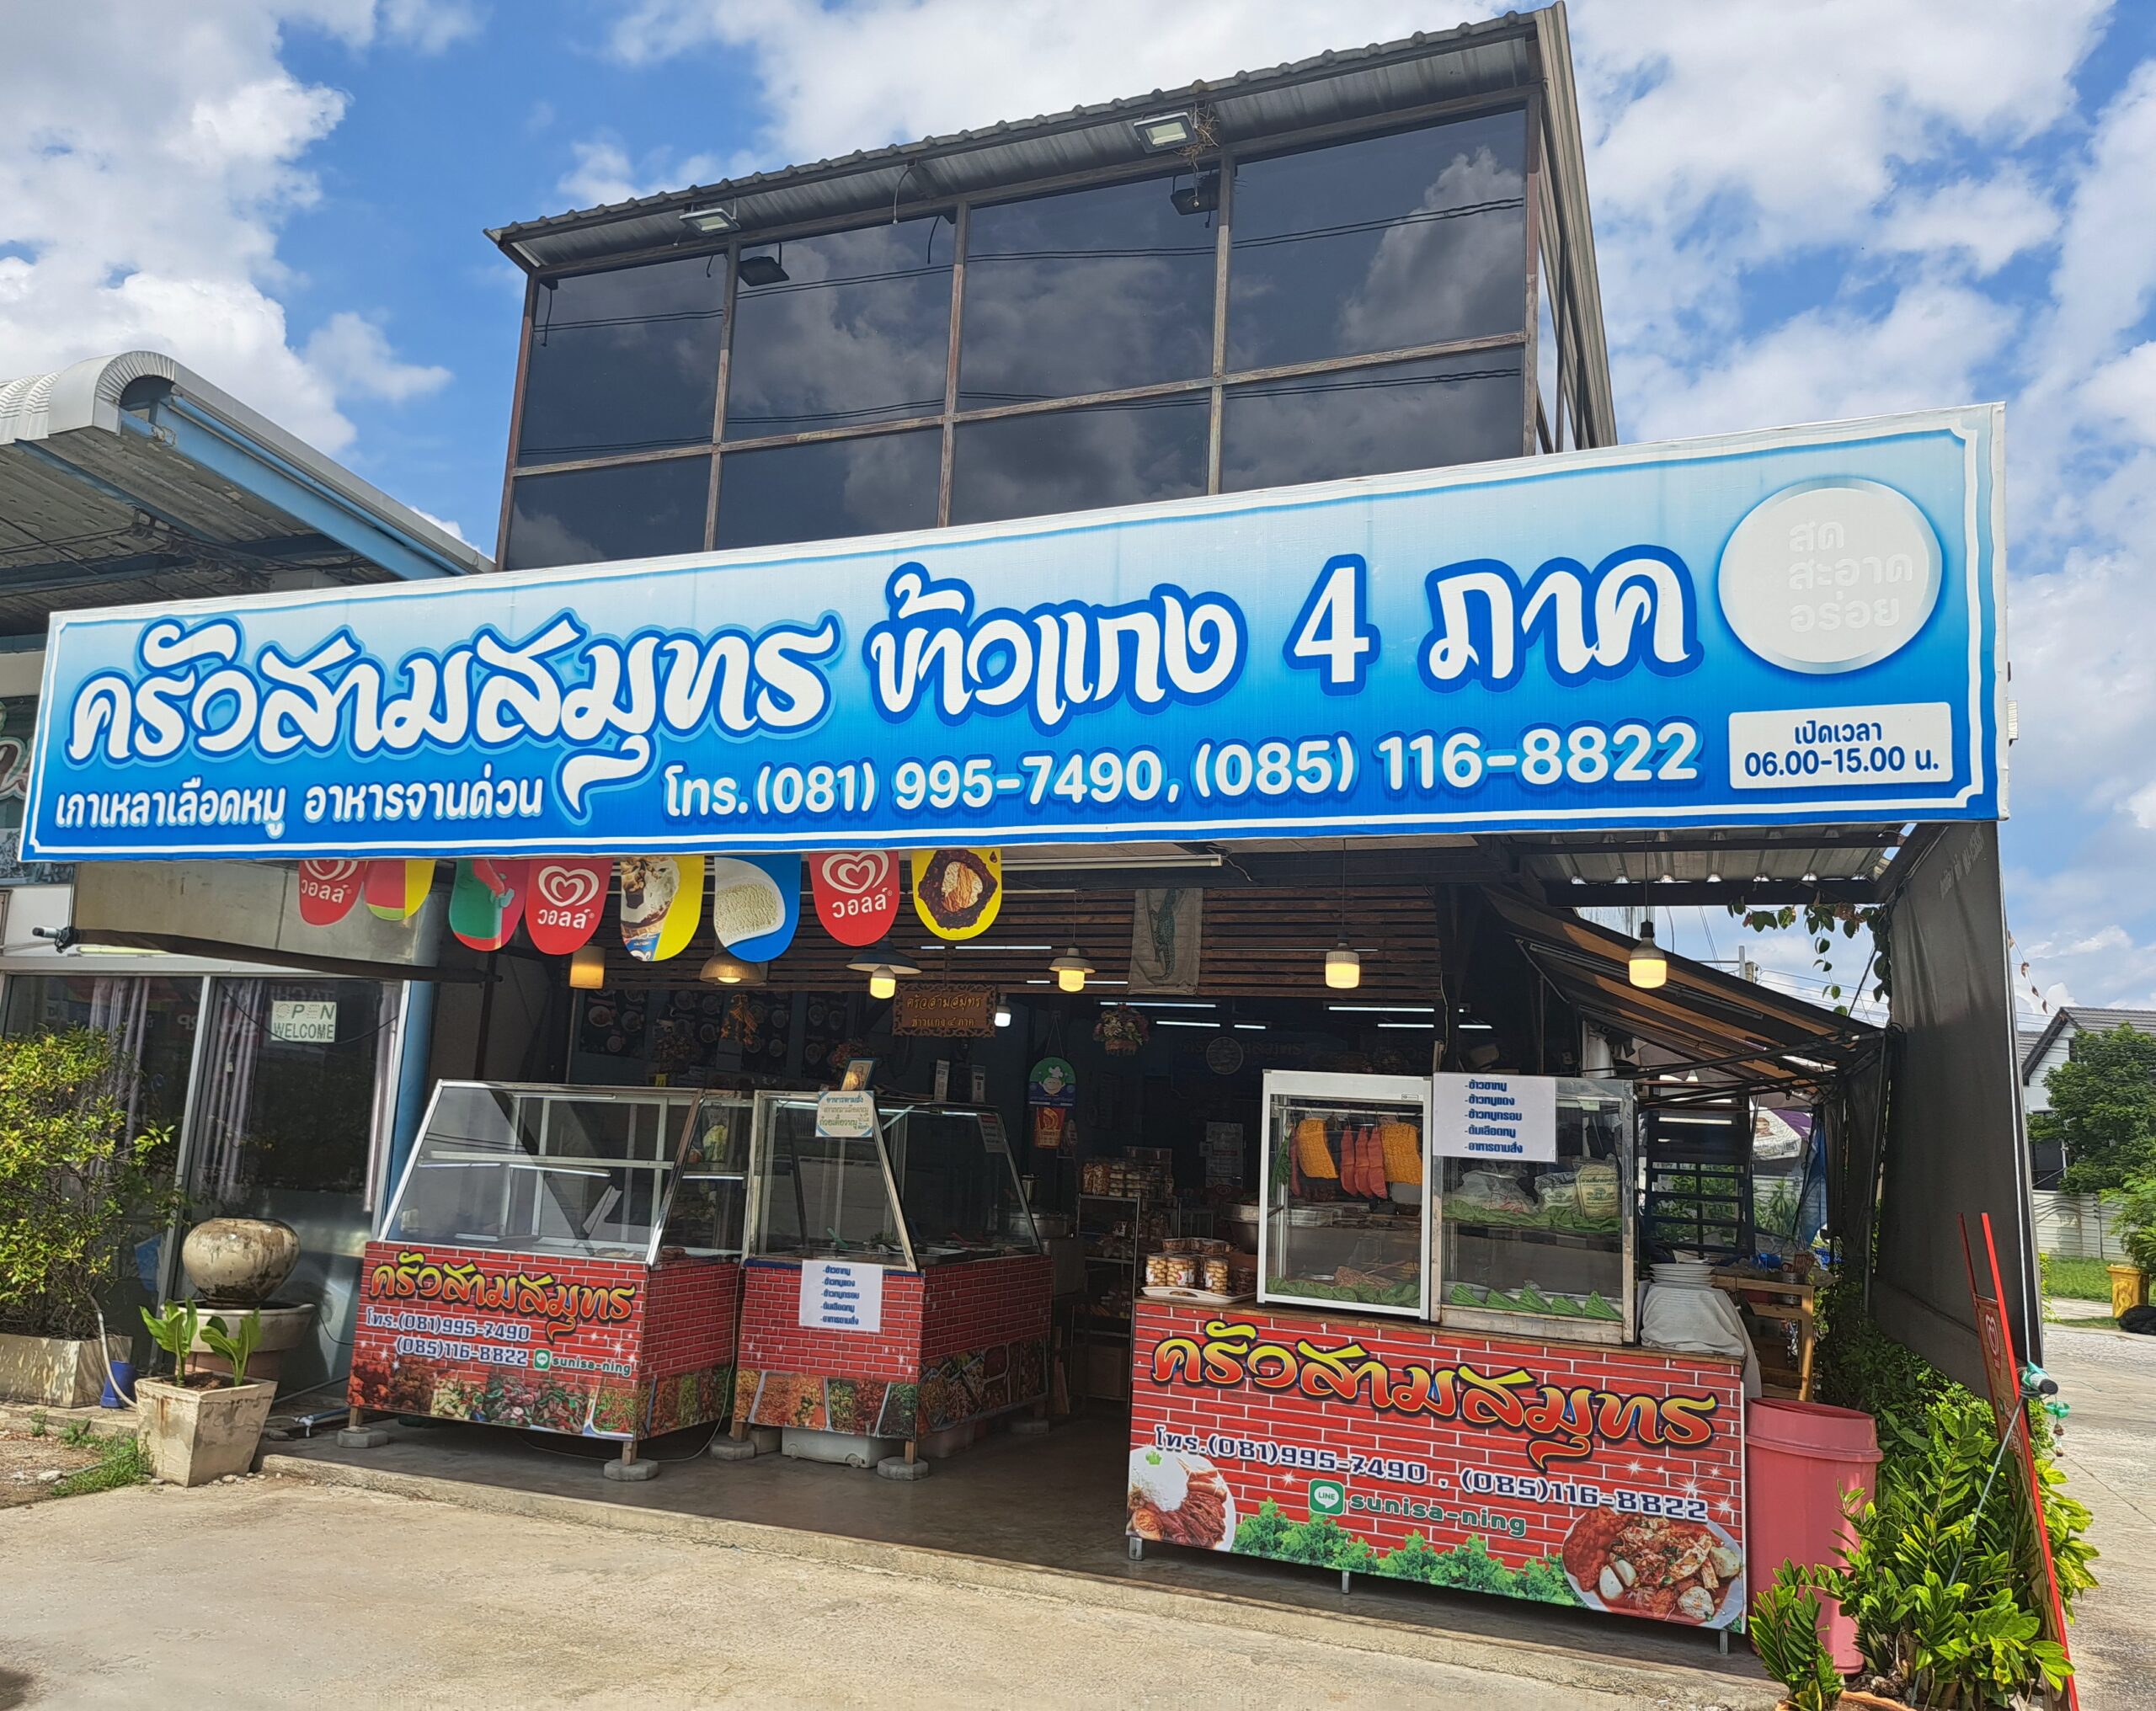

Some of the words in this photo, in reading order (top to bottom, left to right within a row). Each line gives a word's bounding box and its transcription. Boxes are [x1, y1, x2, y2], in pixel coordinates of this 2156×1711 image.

[1788, 520, 1844, 552] สด
[1788, 552, 1913, 591] สะอาด
[1789, 589, 1900, 633] อร่อย
[67, 615, 838, 816] ครัวสามสมุทร
[869, 571, 1239, 727] ข้าวแกง
[1292, 564, 1371, 685] 4
[1428, 557, 1692, 680] ภาค
[1794, 720, 1882, 744] เปิดเวลา
[1195, 736, 1354, 798] (085)
[1375, 721, 1700, 792] 116-8822
[1744, 746, 1906, 777] 06.00-15.00
[1914, 749, 1940, 770] น.
[55, 775, 287, 837] เกาเหลาเลือดหมู
[304, 763, 544, 823] อาหารจานด่วน
[274, 1022, 335, 1040] WELCOME
[368, 1250, 636, 1345] ครัวสามสมุทร
[395, 1335, 529, 1367] (085)116-8822
[552, 1354, 632, 1377] sunisa-ning
[1151, 1319, 1718, 1473] ครัวสามสมุทร
[1317, 1491, 1337, 1503] LINE
[1348, 1490, 1527, 1538] sunisa-ning
[1460, 1465, 1709, 1523] (085)116-8822
